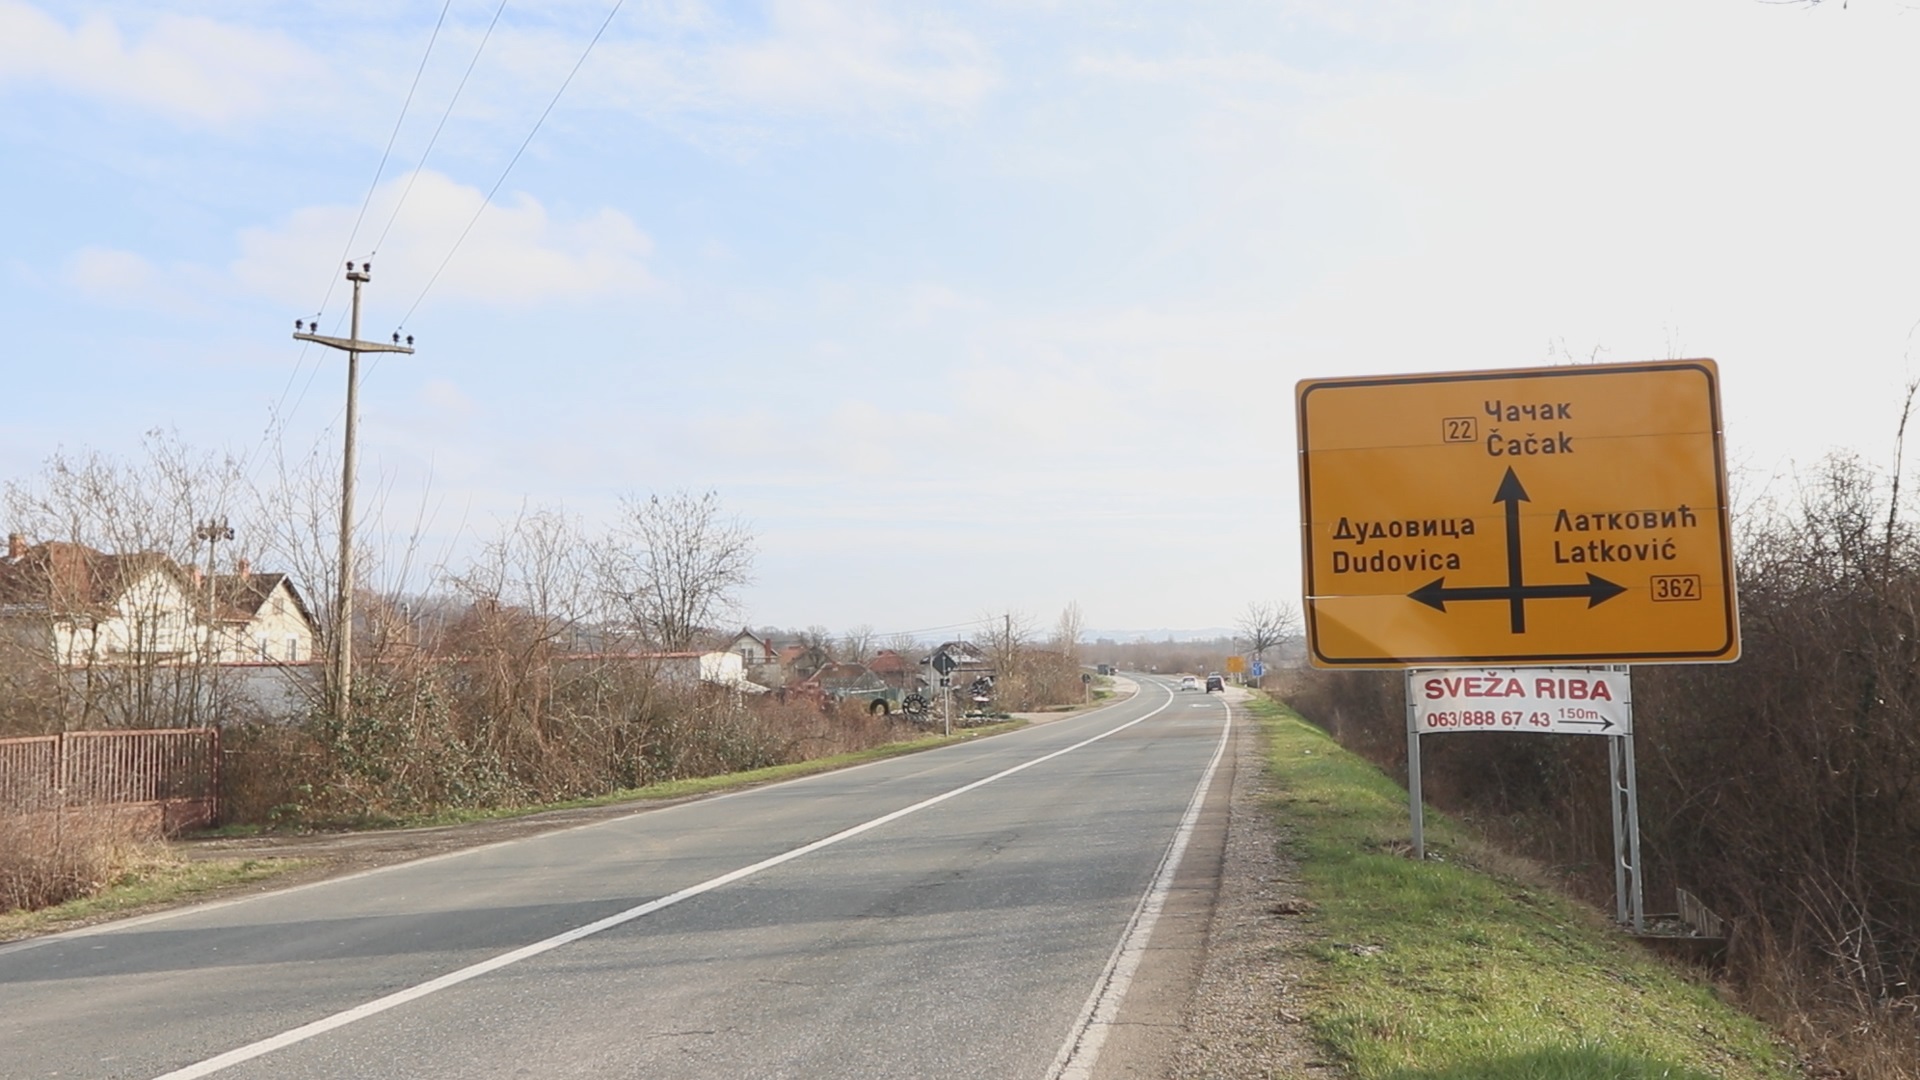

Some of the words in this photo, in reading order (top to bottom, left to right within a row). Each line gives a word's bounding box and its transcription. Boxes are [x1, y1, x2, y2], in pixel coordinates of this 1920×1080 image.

[1484, 400, 1572, 422] Чачак
[1448, 421, 1472, 440] 22
[1487, 429, 1573, 457] Čačak
[1332, 516, 1476, 545] Дудовица
[1554, 505, 1697, 533] Латковић
[1332, 550, 1461, 574] Dudovica
[1554, 538, 1677, 565] Latković
[1657, 578, 1695, 599] 362
[1424, 672, 1526, 700] SVEŽA
[1535, 678, 1612, 701] RIBA
[1427, 711, 1496, 728] 063/888
[1501, 711, 1524, 726] 67
[1529, 712, 1551, 727] 43
[1559, 708, 1598, 720] 150m
